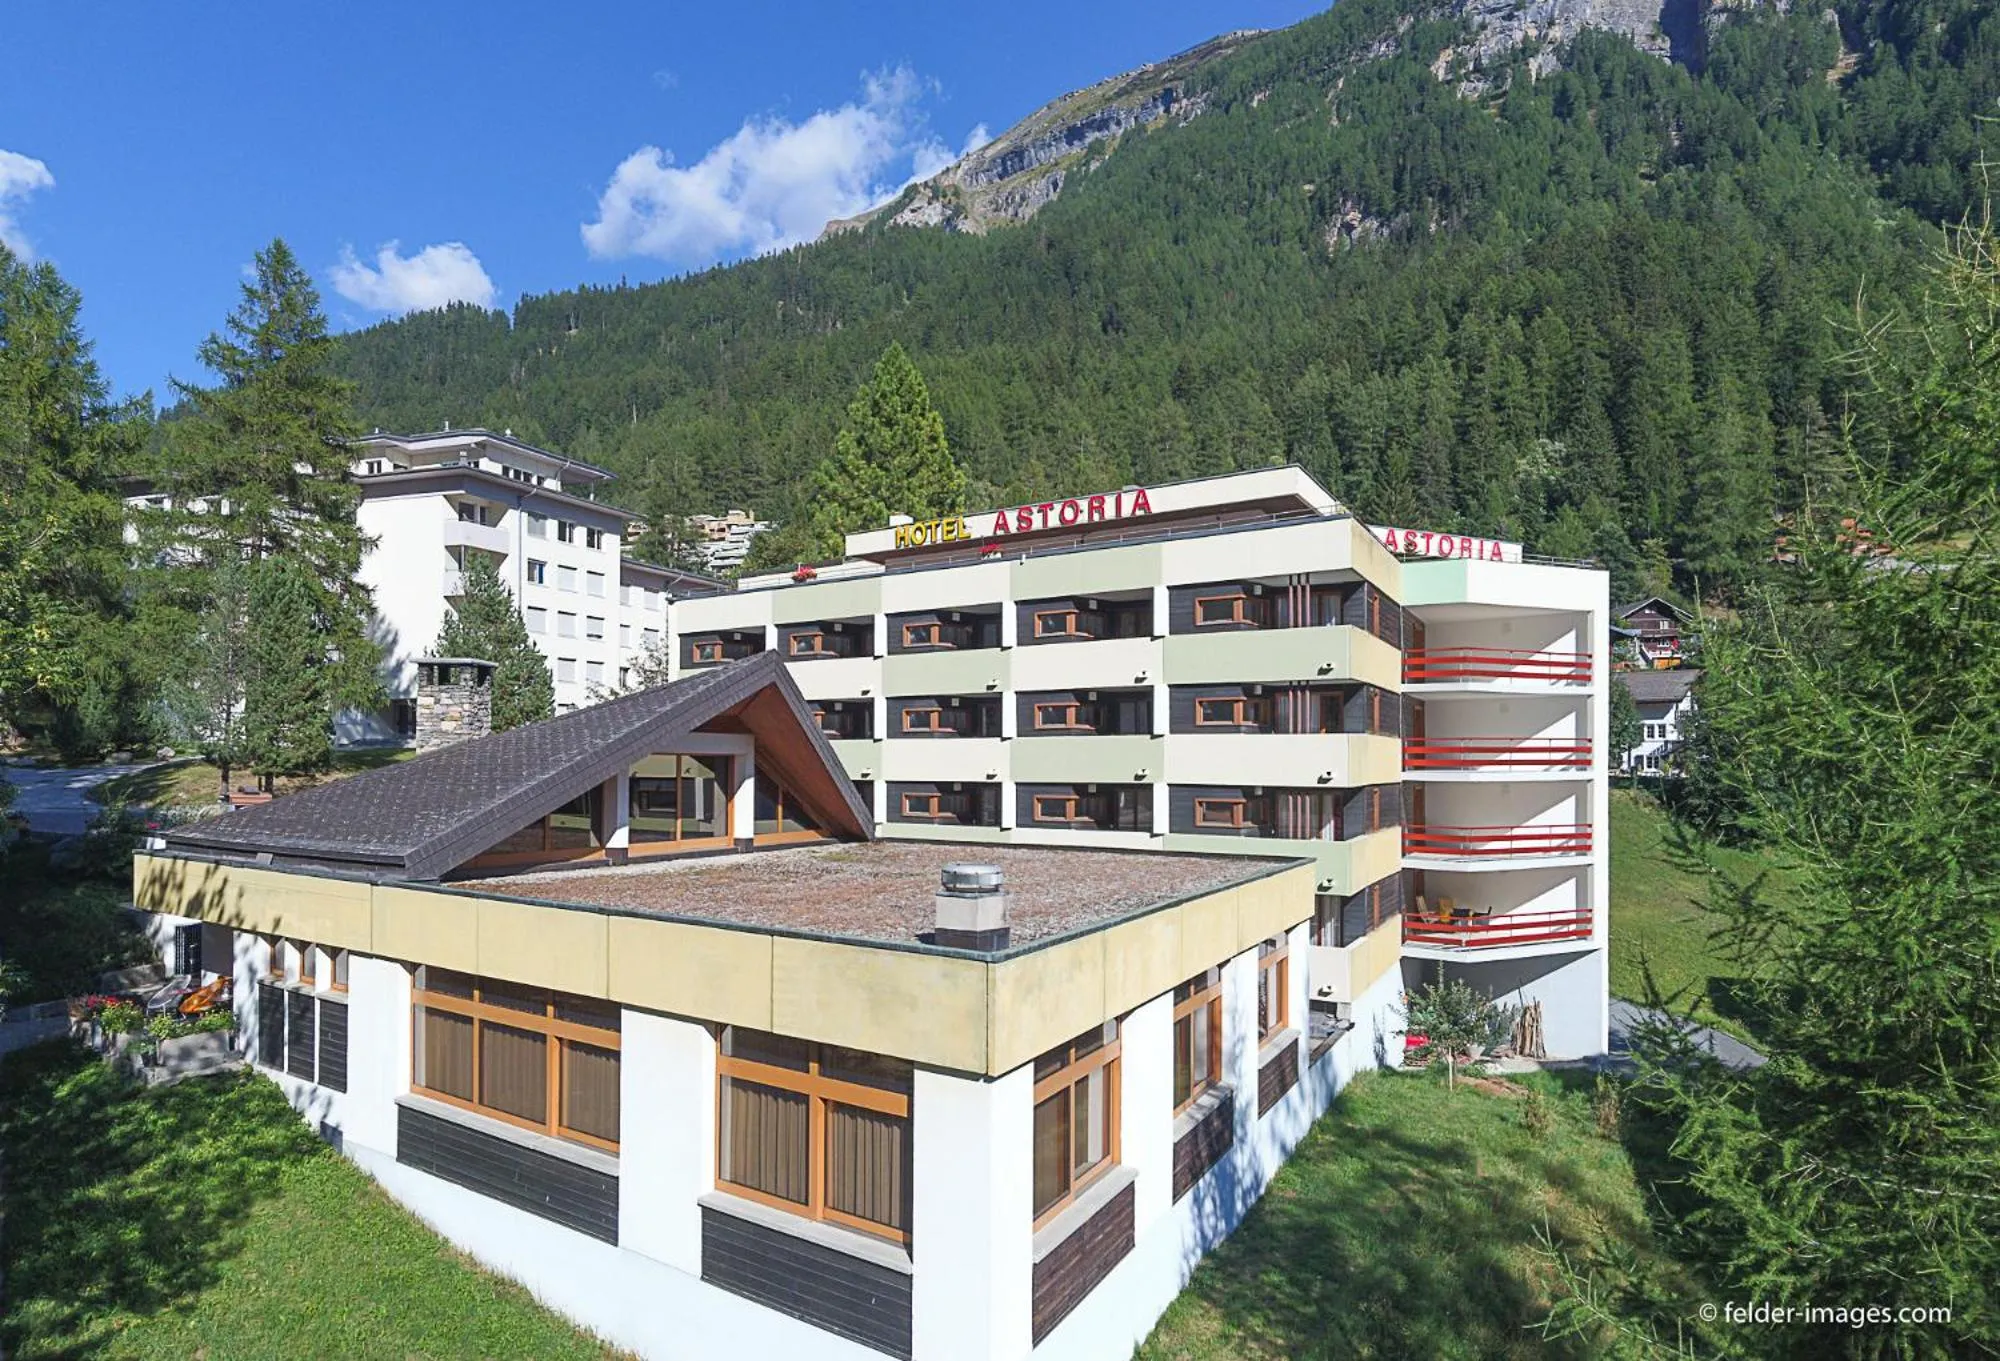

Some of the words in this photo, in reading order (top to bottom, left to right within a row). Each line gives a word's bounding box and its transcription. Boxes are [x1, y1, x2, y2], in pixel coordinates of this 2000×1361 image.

[896, 516, 972, 548] HOTEL
[993, 488, 1152, 535] ASTORIA
[1385, 527, 1503, 561] ASTORIA
